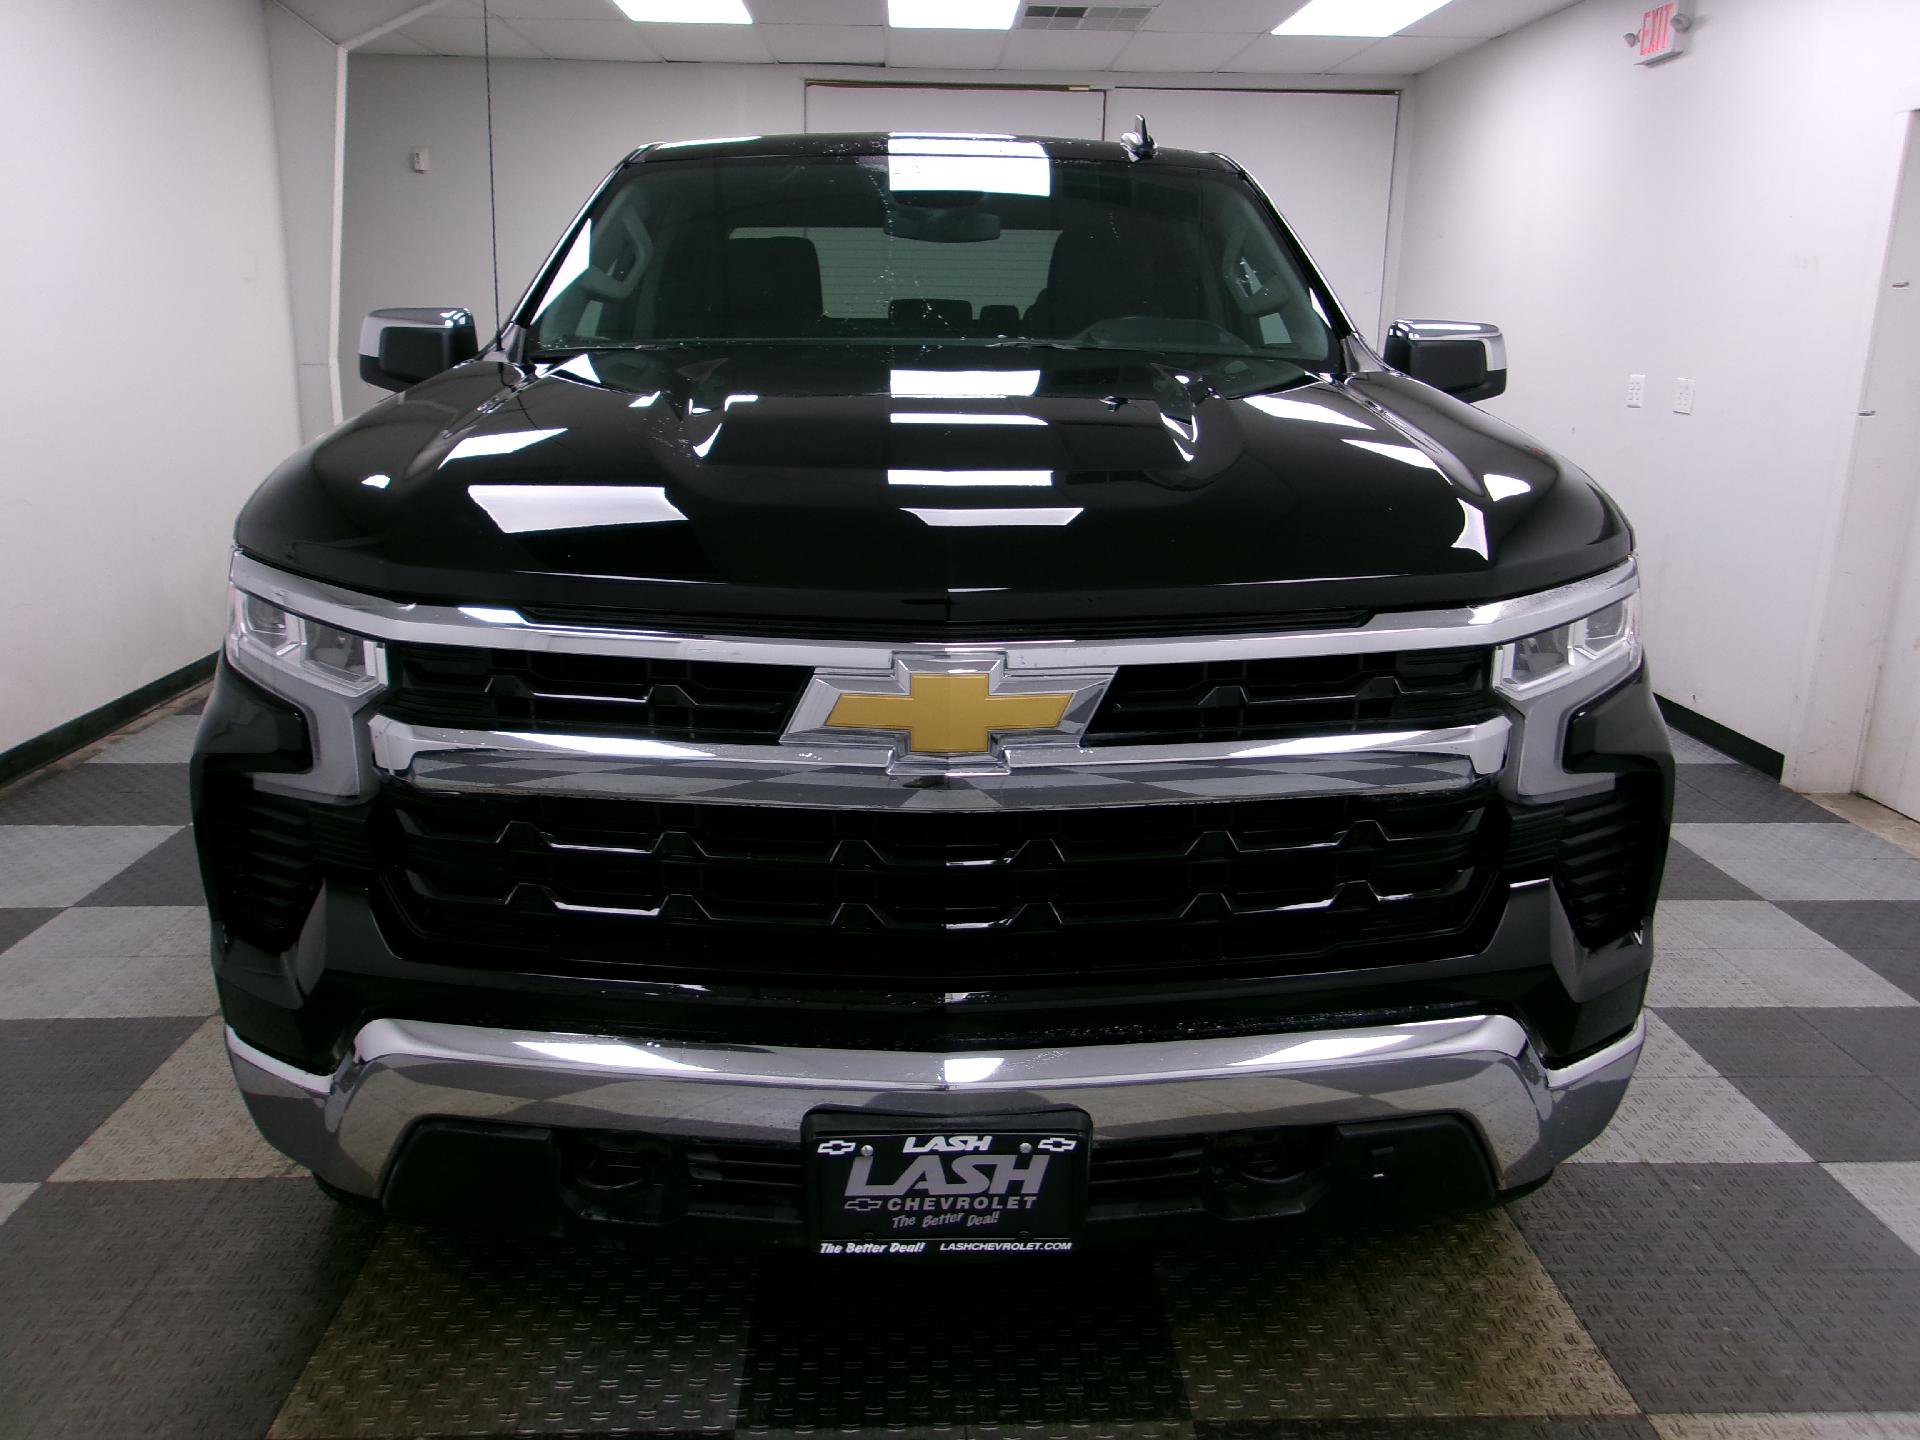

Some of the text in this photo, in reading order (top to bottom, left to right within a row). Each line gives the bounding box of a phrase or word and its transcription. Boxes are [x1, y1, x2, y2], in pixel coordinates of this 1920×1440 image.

[1640, 3, 1674, 56] EXIT
[902, 1135, 993, 1153] LASH
[845, 1154, 1050, 1196] LASH
[887, 1196, 1038, 1211] CHEVROLET
[892, 1211, 1000, 1229] The Better Deal!
[820, 1242, 926, 1253] The Better Deal!
[940, 1241, 1072, 1251] LASHCHEVROLET.COM
